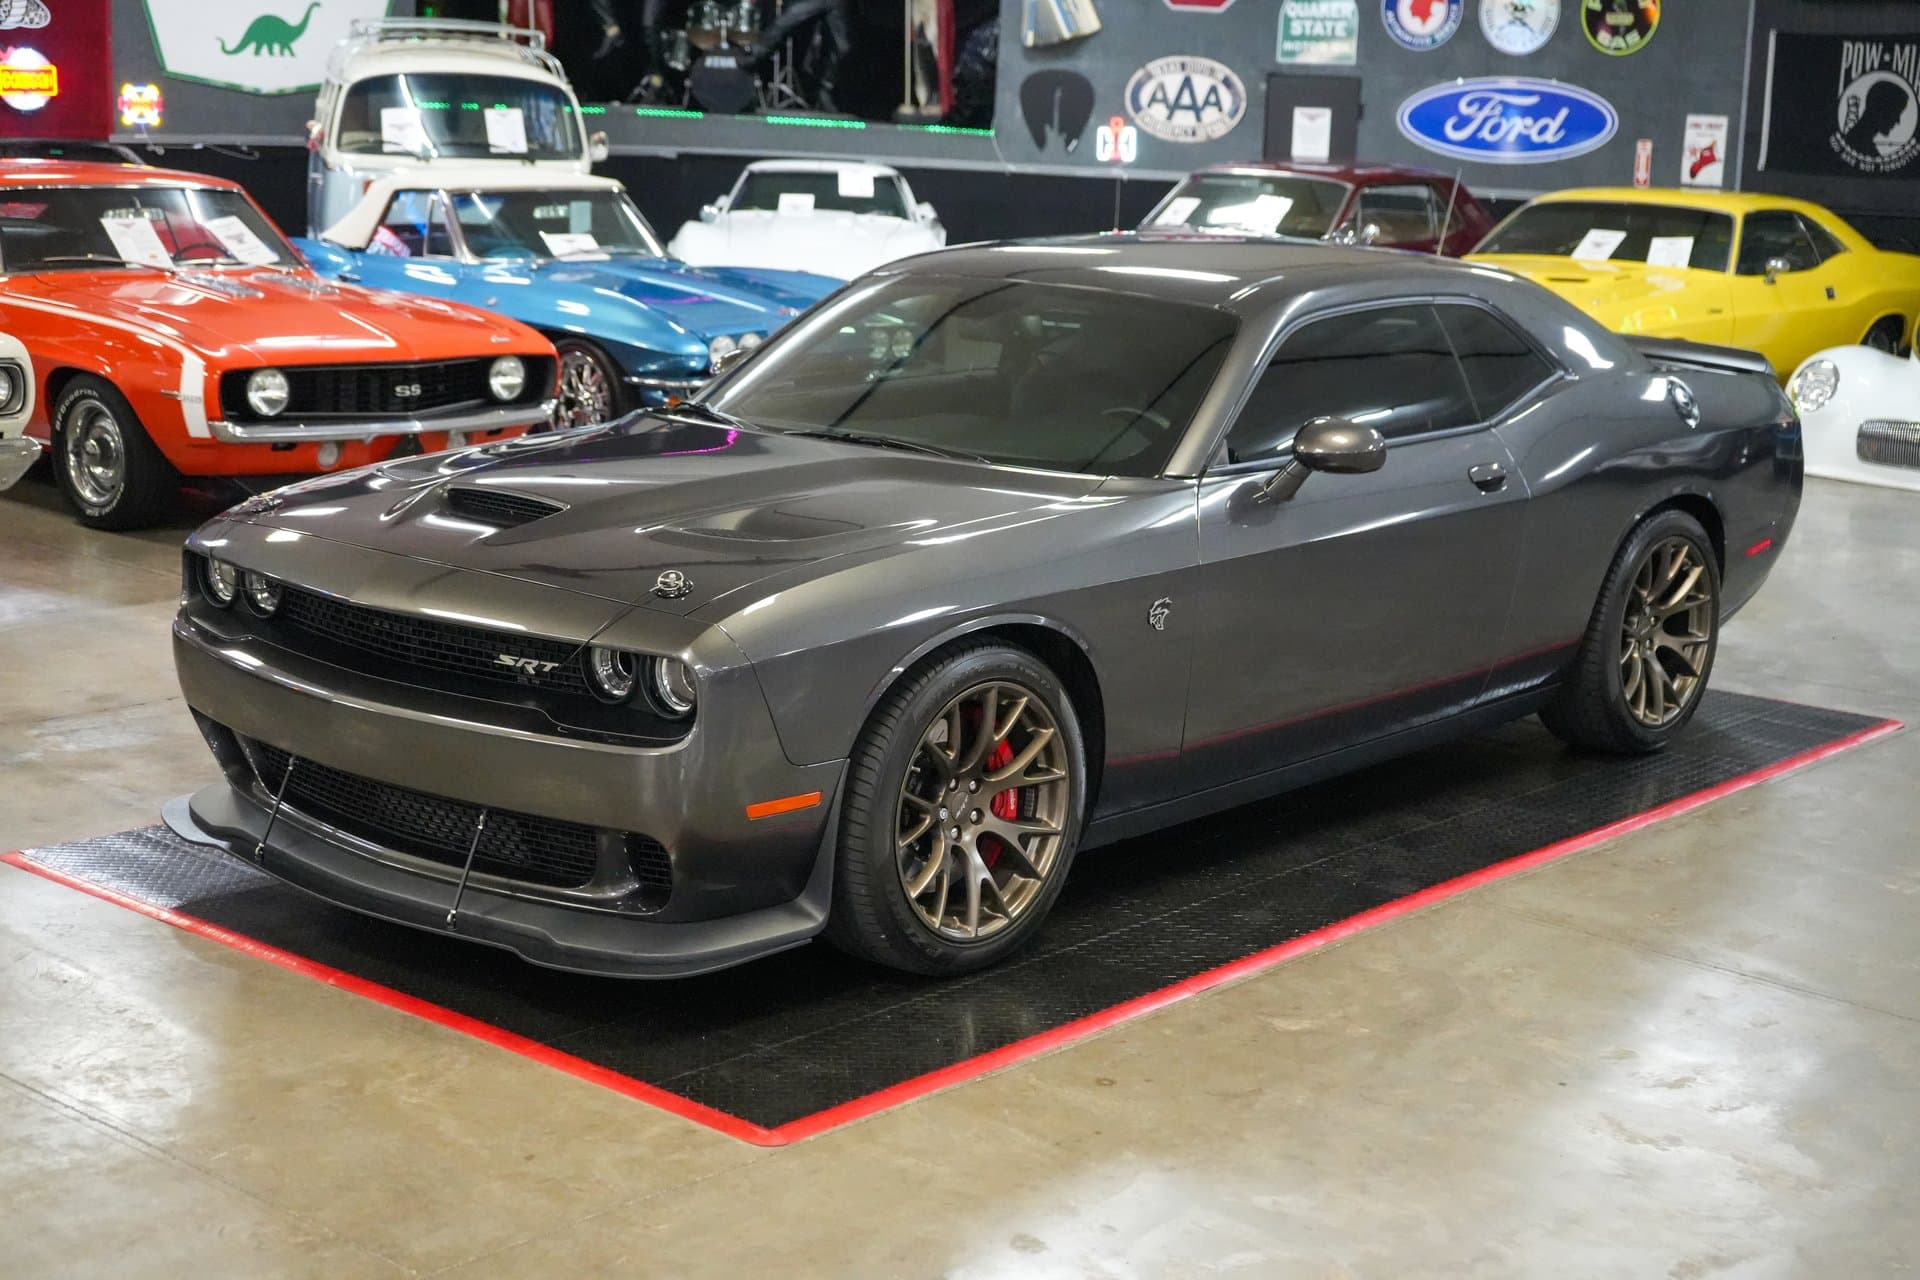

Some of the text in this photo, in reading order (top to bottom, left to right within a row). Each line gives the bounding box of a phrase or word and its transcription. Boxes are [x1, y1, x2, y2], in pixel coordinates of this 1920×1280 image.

[1290, 19, 1347, 37] STATE
[1838, 40, 1884, 98] POW
[1147, 75, 1223, 122] AAA
[1444, 91, 1569, 143] Ford
[55, 388, 100, 432] BFGoodrich
[394, 383, 421, 397] SS
[493, 654, 559, 675] SRT
